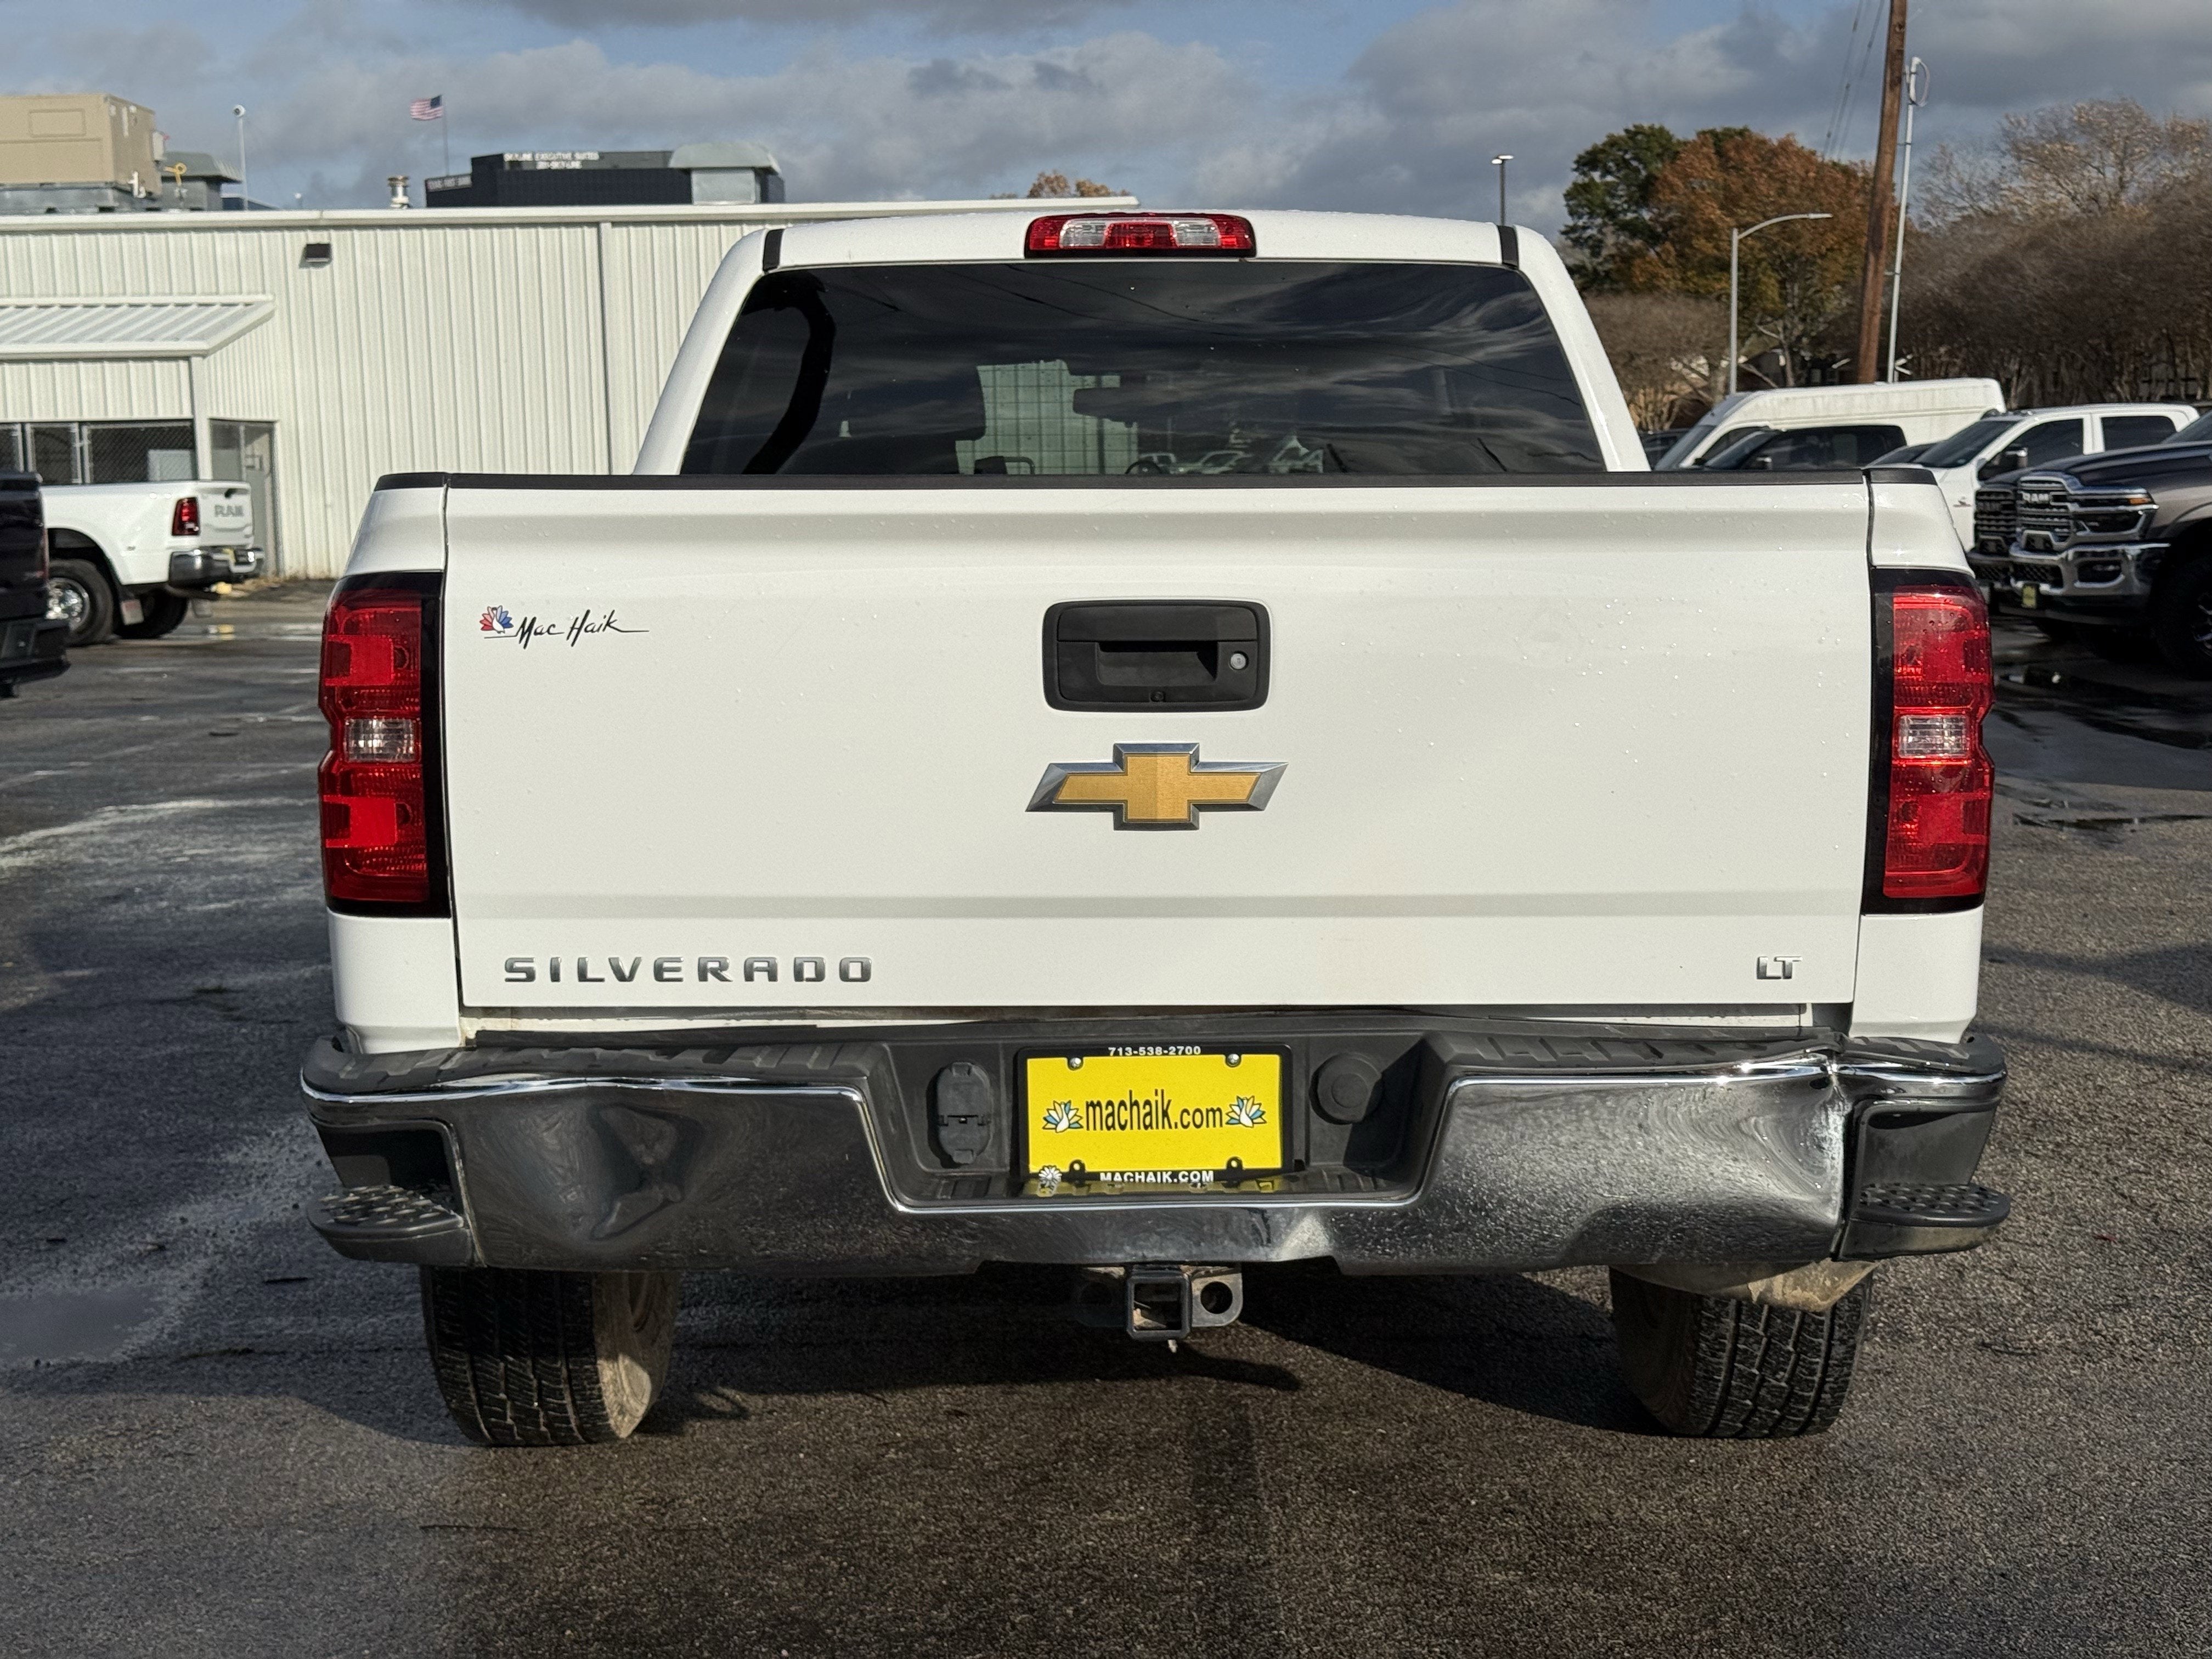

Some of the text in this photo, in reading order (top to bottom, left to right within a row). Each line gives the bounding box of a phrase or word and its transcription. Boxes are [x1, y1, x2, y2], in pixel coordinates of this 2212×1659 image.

[2022, 492, 2049, 503] RAM
[214, 505, 245, 517] RAM
[515, 609, 650, 650] Mac Haik
[504, 956, 873, 983] SILVERADO
[1756, 956, 1803, 980] LT
[1108, 1046, 1201, 1057] 713-538-2700
[1085, 1089, 1223, 1131] machaik.com
[1099, 1170, 1214, 1183] MACHAIK.COM
